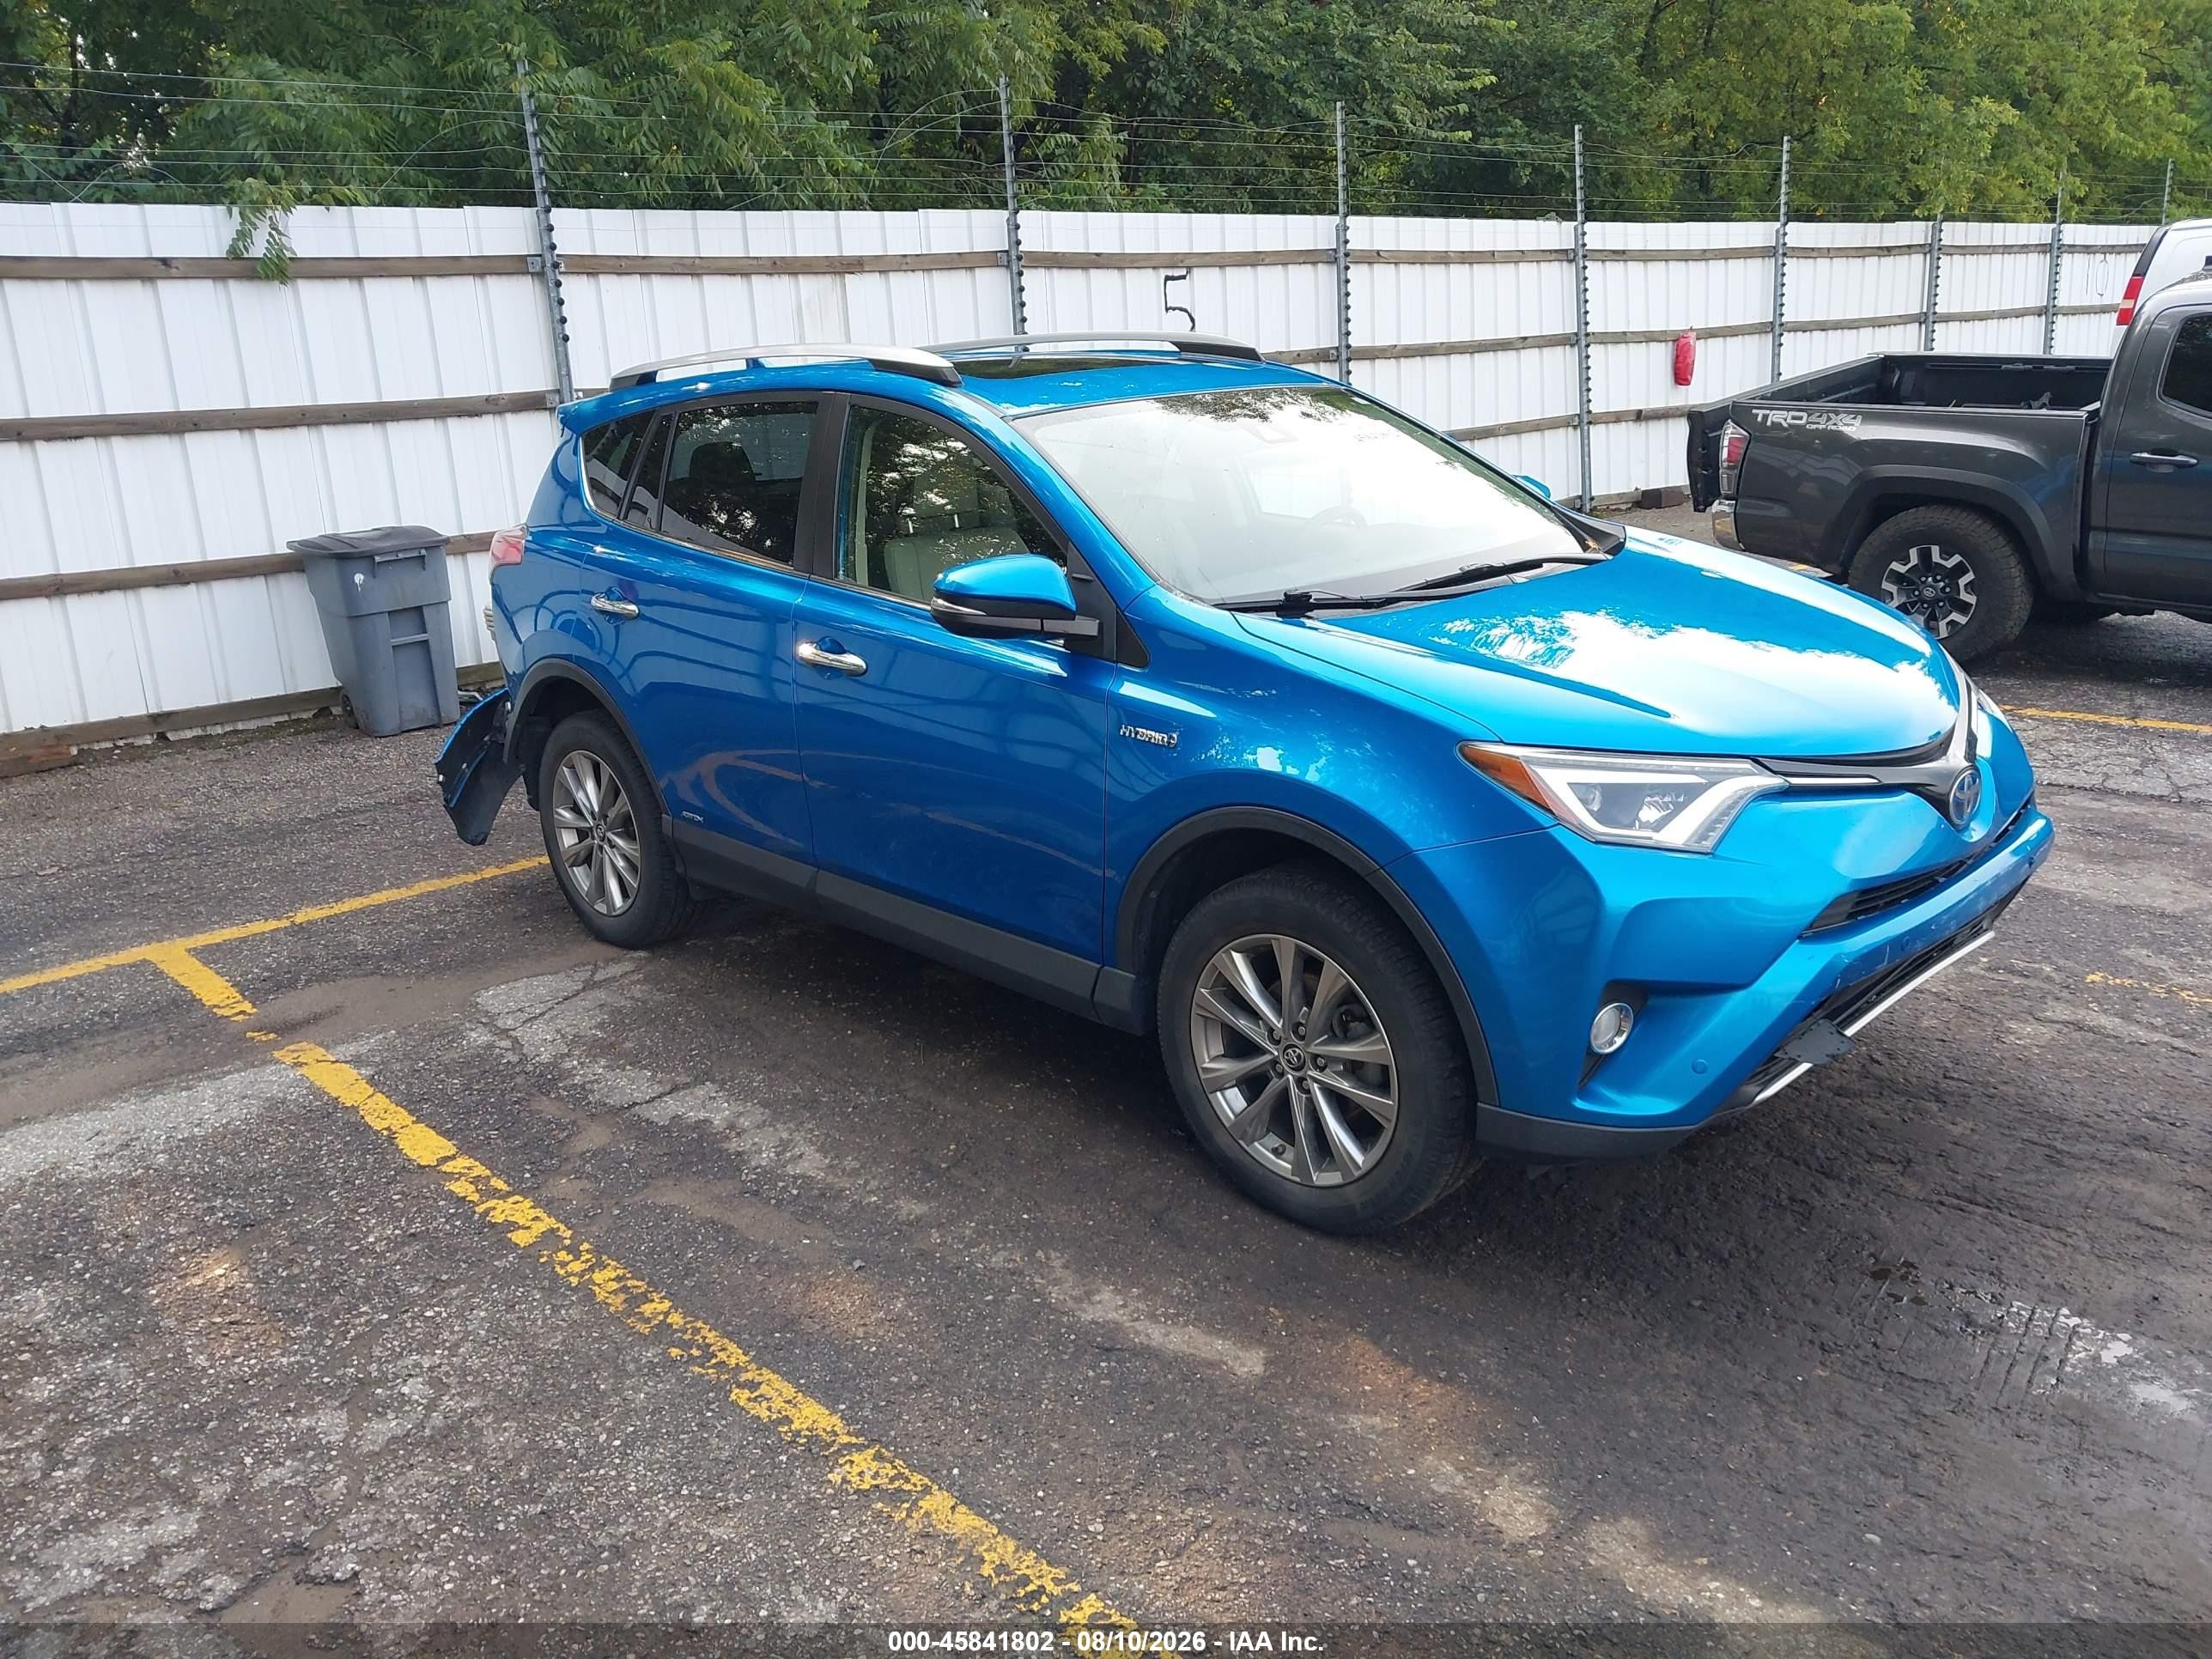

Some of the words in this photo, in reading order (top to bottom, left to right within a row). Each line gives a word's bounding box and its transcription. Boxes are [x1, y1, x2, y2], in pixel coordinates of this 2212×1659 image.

[1164, 268, 1195, 332] 5
[1752, 409, 1808, 428] TRD
[1120, 724, 1177, 748] HYBRID
